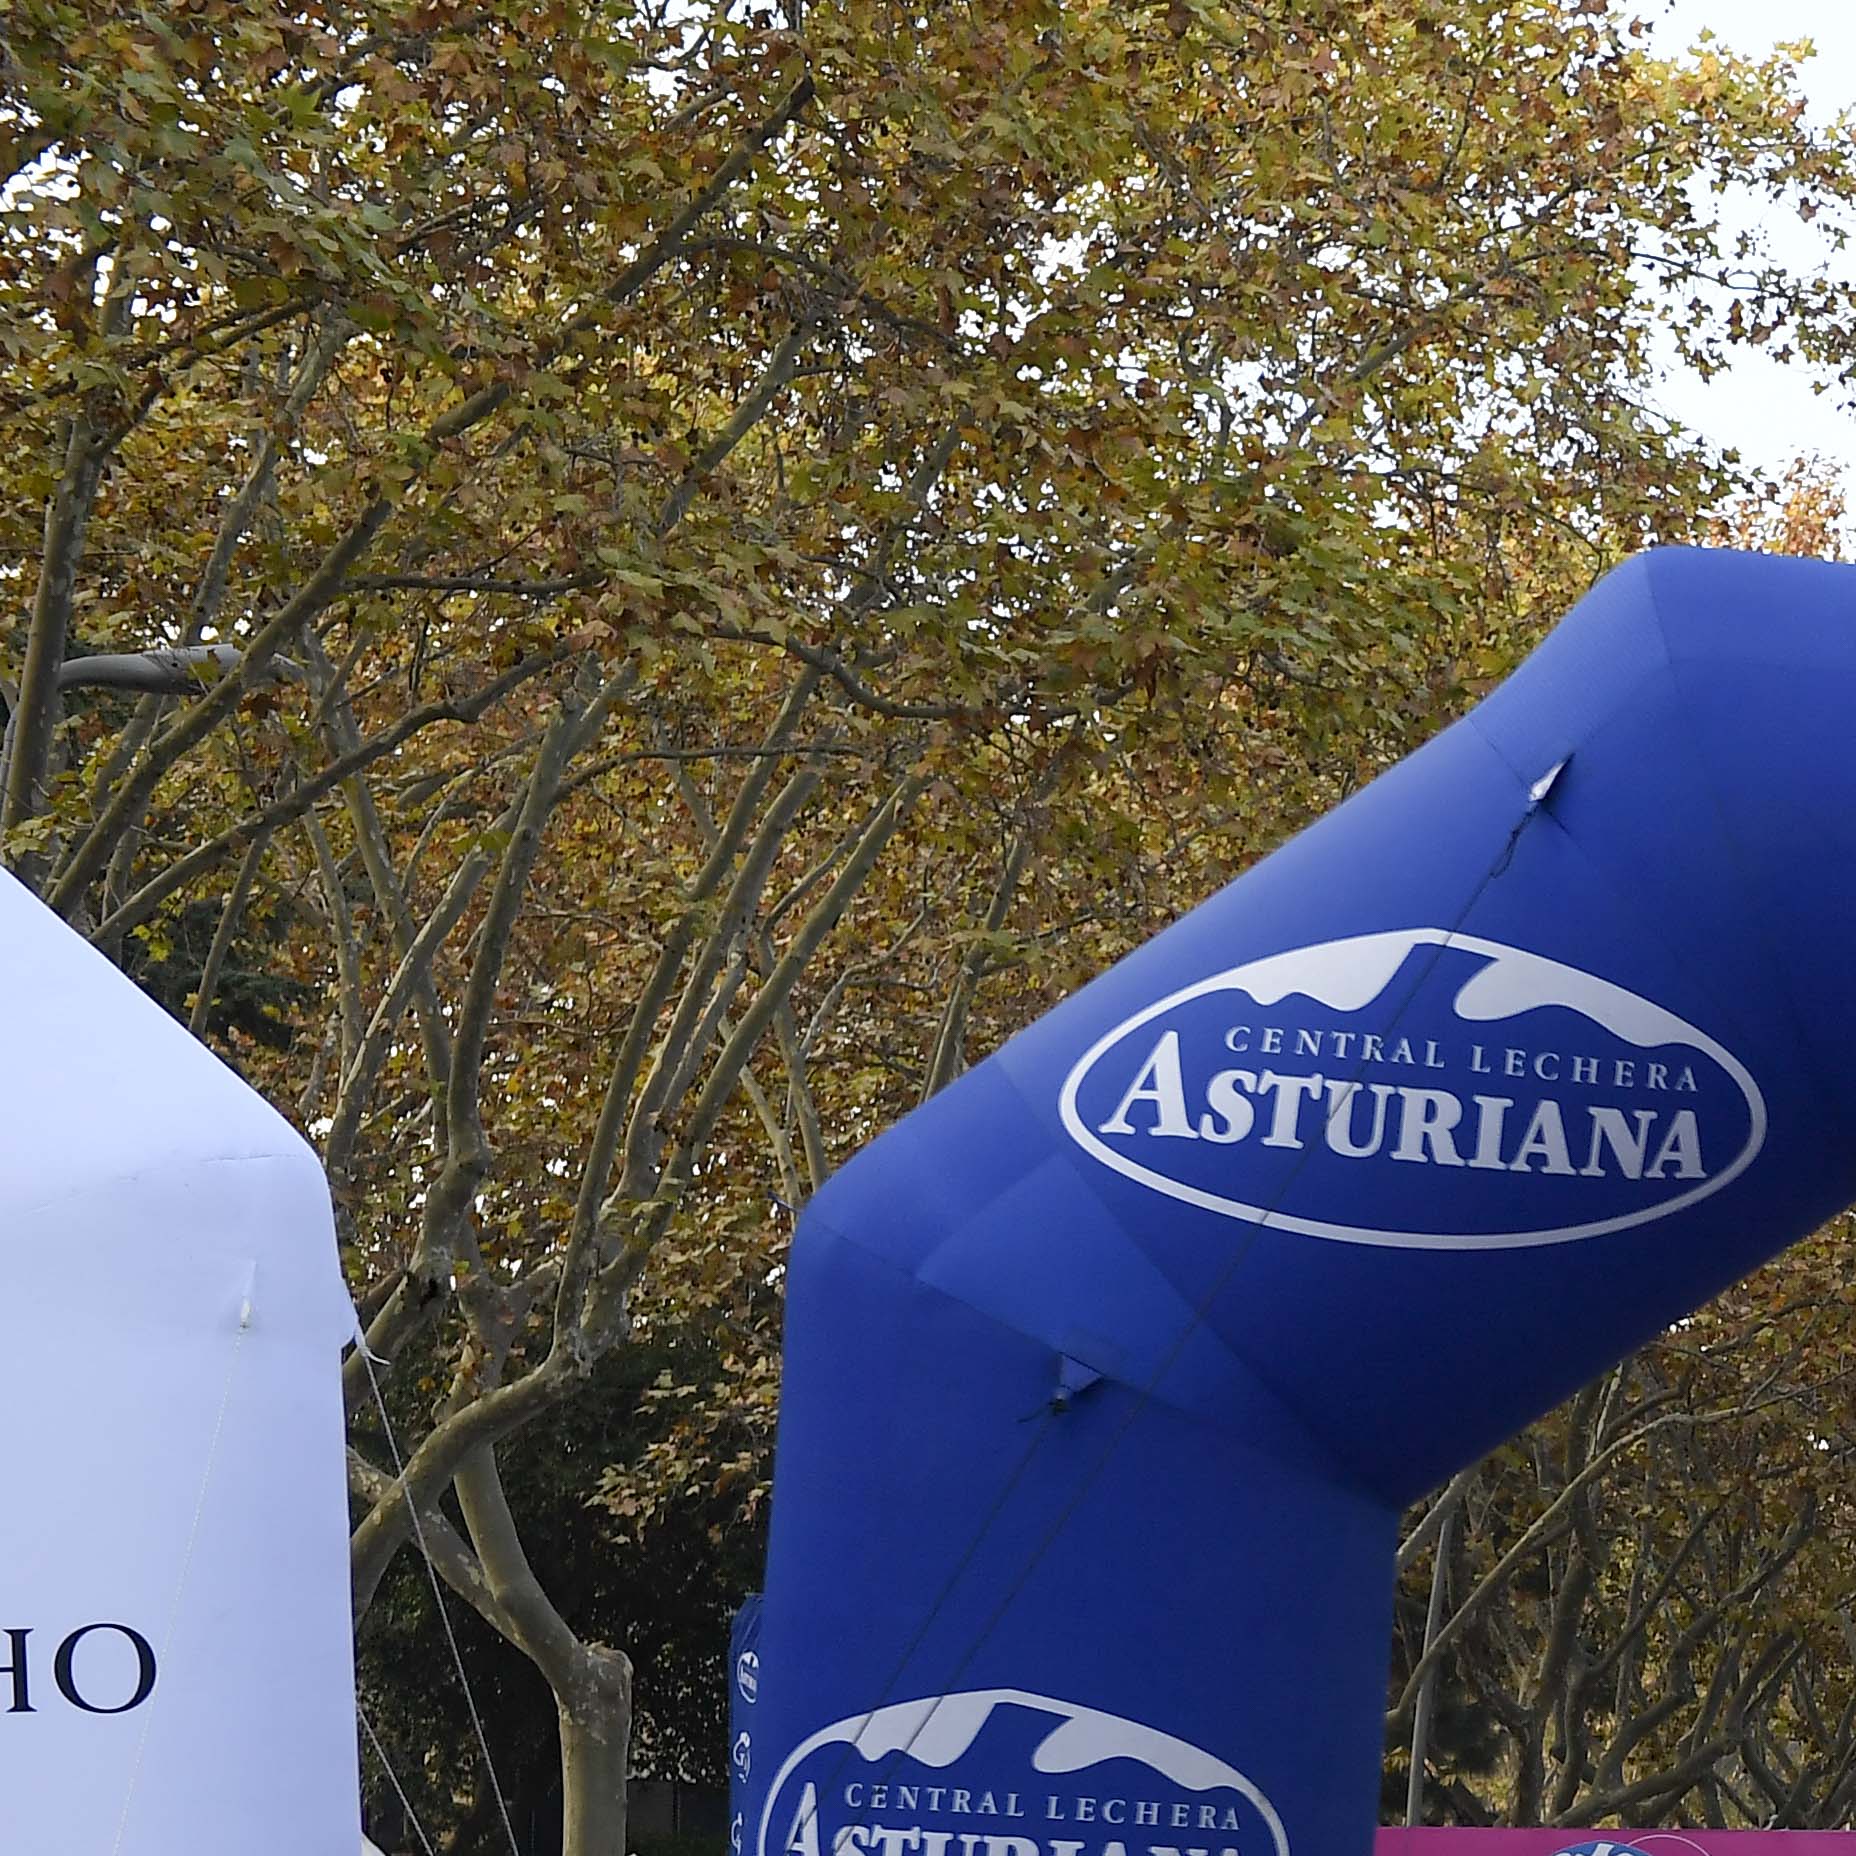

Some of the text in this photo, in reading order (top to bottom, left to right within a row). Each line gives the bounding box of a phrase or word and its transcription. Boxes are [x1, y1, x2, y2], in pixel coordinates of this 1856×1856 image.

[1225, 1024, 1700, 1094] CENTRAL LECHERA
[1099, 1029, 1709, 1182] ASTURIANA
[845, 1781, 1241, 1832] CENTRAL LECHERA
